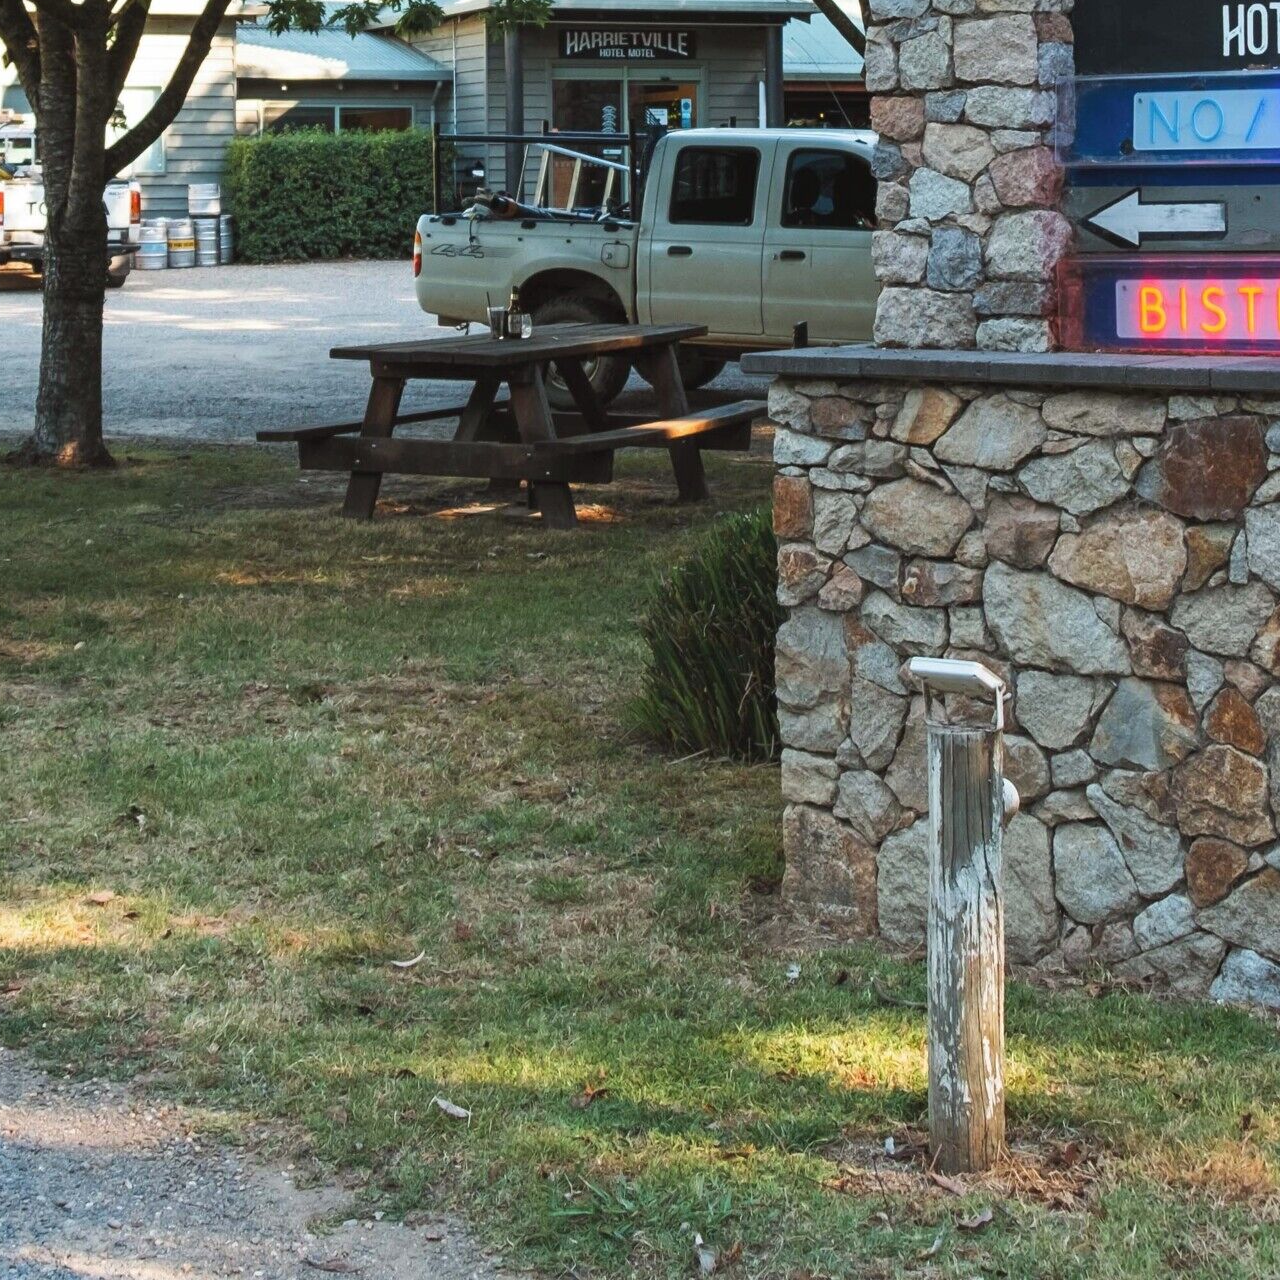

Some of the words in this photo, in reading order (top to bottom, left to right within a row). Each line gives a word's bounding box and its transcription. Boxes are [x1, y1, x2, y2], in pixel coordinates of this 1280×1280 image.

[566, 31, 688, 56] HARRIETVILLE
[599, 48, 626, 58] HOTEL
[628, 48, 655, 58] MOTEL
[1150, 97, 1225, 143] NO
